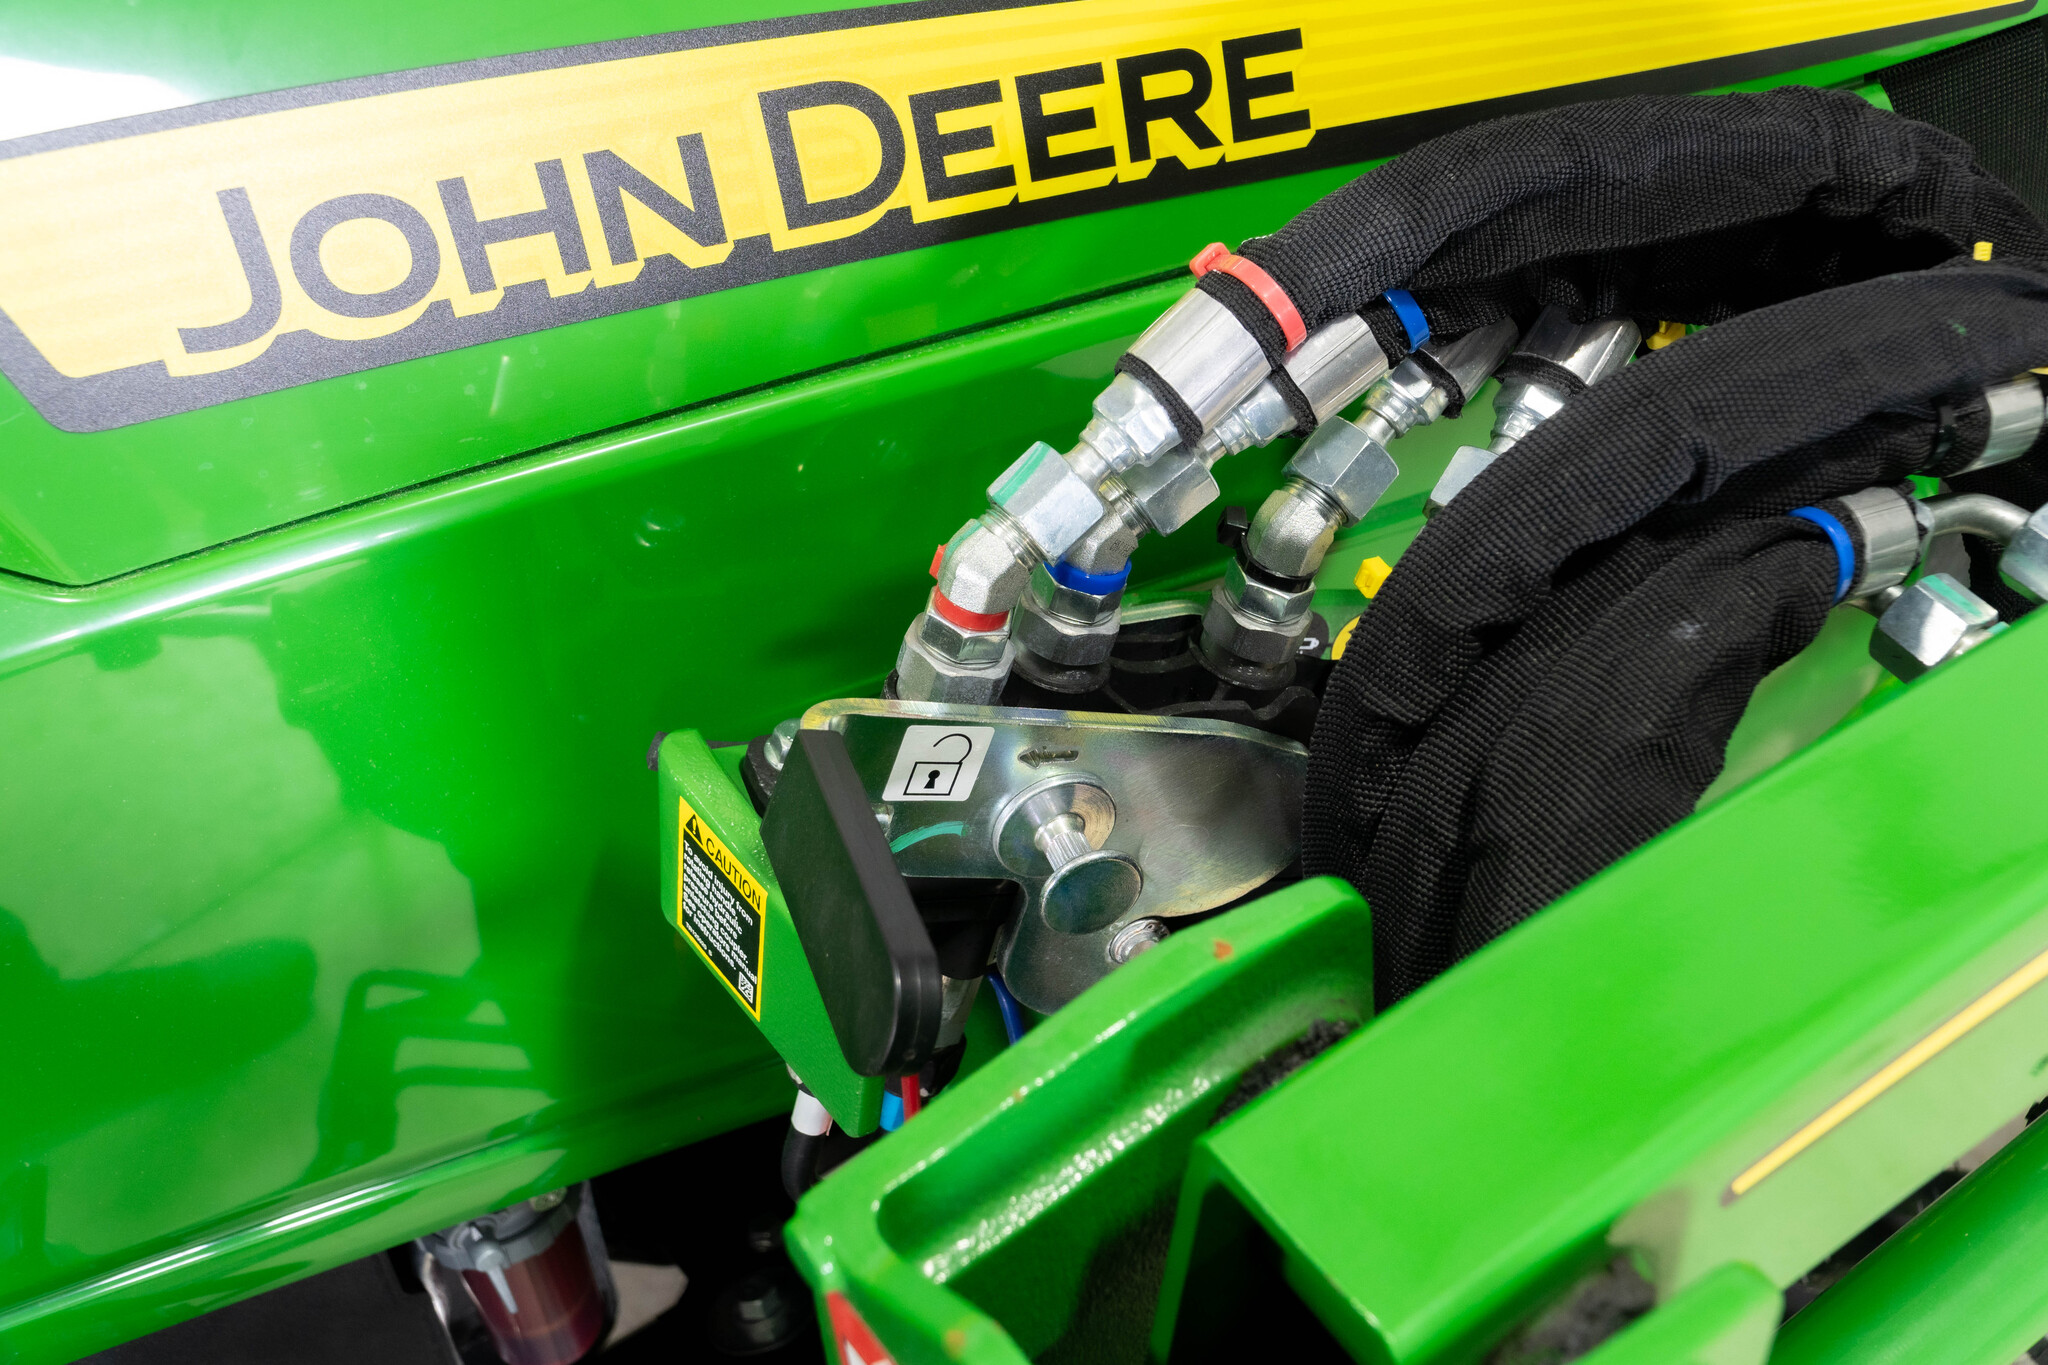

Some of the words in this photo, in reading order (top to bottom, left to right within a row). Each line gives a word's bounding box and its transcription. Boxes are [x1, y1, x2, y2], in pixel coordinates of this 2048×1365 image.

[177, 132, 729, 355] JOHN
[757, 28, 1312, 231] DEERE
[683, 840, 693, 856] To
[693, 854, 713, 880] avoid
[713, 875, 735, 905] injury
[735, 901, 753, 926] from
[683, 853, 710, 889] rotating
[711, 883, 737, 920] handle,
[683, 863, 708, 895] release
[709, 891, 742, 934] hydraulic
[683, 873, 713, 911] pressure
[714, 907, 737, 939] before
[707, 838, 760, 910] CAUTION
[682, 883, 719, 930] unlatching
[719, 927, 748, 963] coupler.
[682, 901, 693, 917] for
[693, 914, 736, 970] instructions.
[682, 892, 696, 911] See
[730, 949, 757, 984] manual
